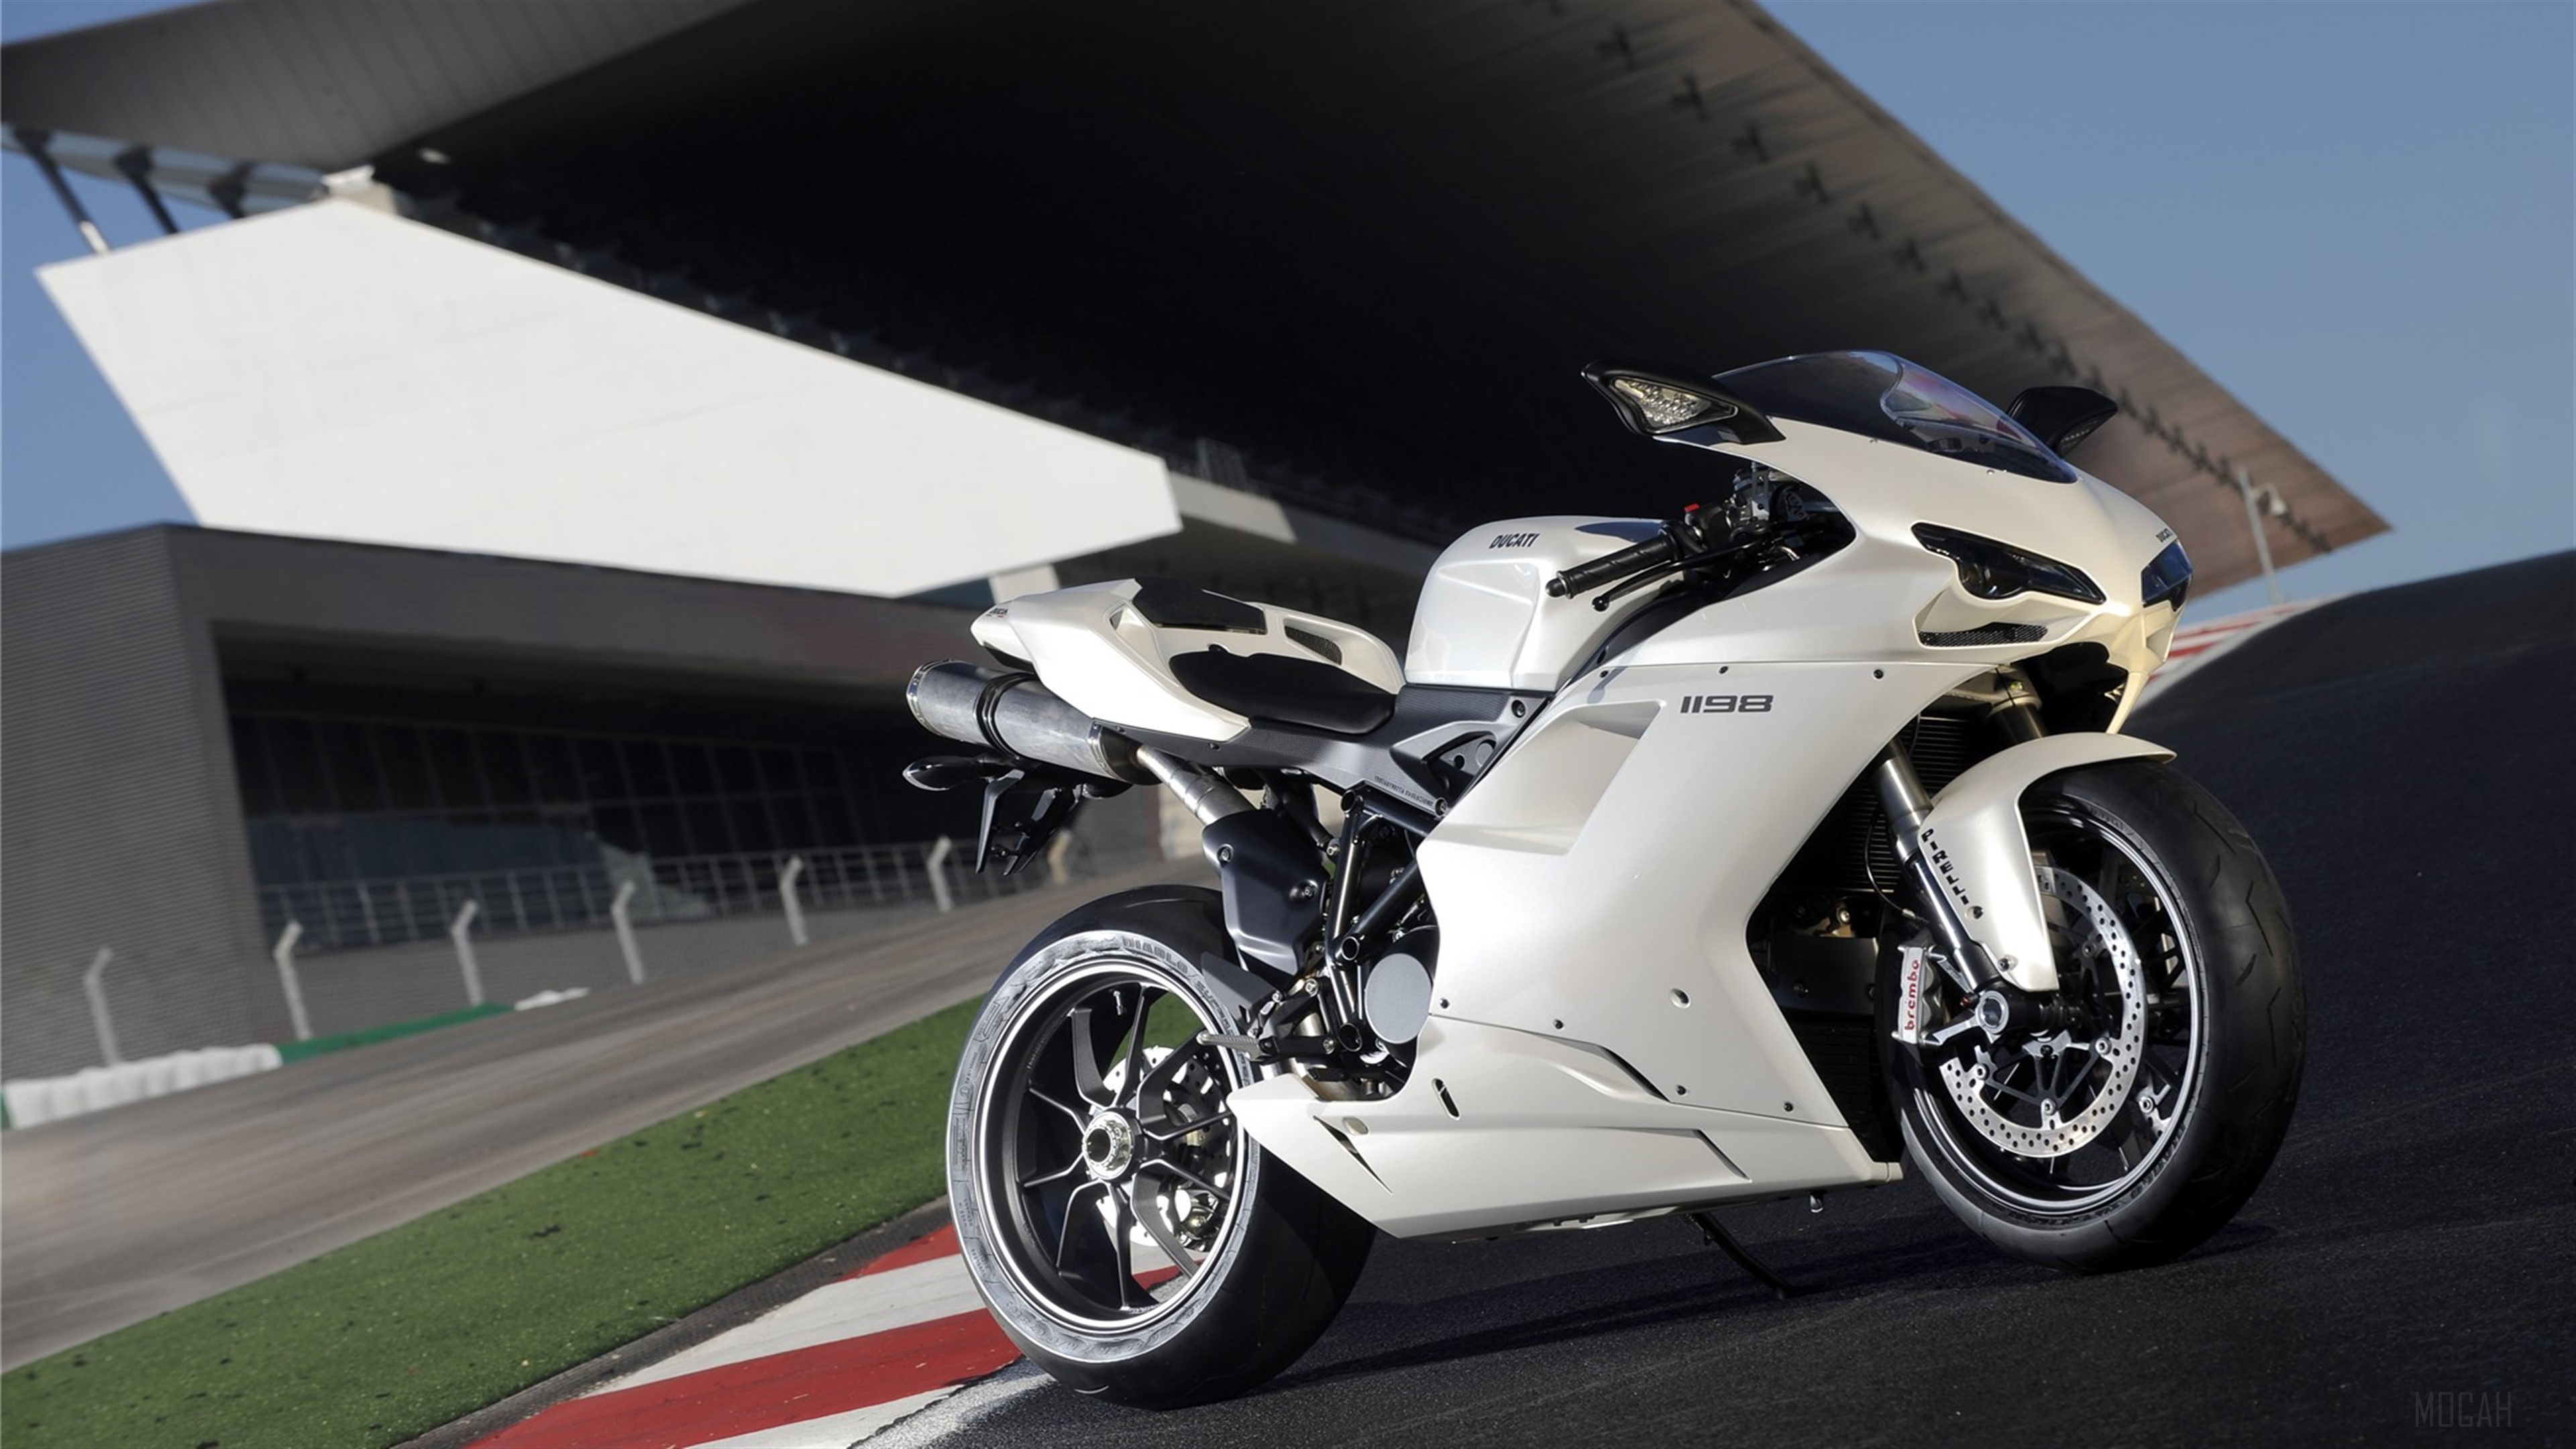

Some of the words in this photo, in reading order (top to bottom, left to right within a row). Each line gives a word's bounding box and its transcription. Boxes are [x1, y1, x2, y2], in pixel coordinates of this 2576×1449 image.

[1489, 533, 1540, 549] DUCATI
[1680, 695, 1774, 713] 1198
[1921, 828, 1970, 906] PIRELLI
[1904, 959, 1920, 1031] brembo
